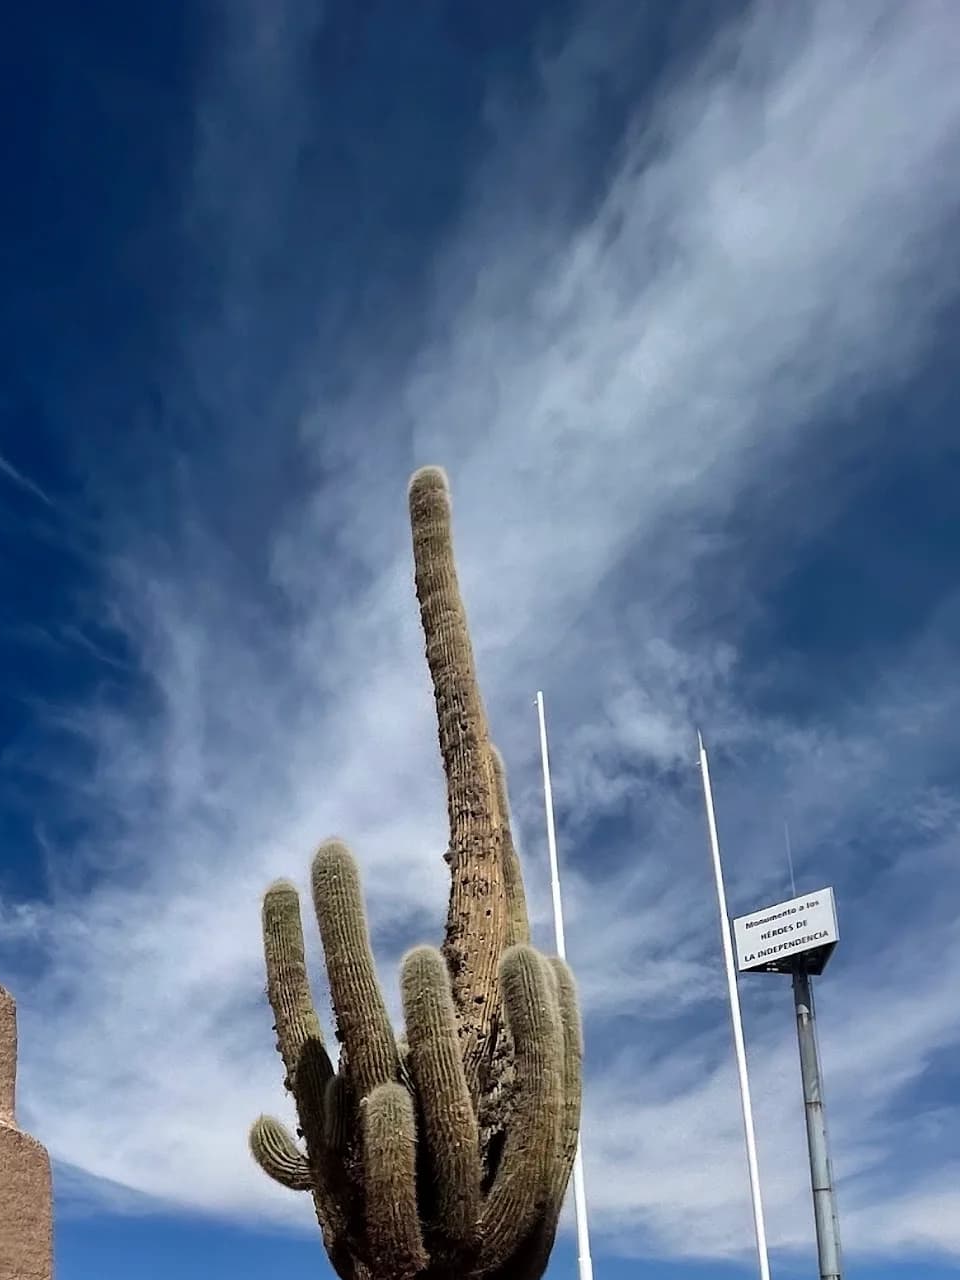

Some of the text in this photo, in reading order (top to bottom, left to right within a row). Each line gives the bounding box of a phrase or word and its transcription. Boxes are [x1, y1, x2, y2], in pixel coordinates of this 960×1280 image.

[798, 904, 805, 912] a
[806, 900, 820, 909] los
[796, 919, 808, 929] DE
[744, 930, 829, 962] LA INDEPENDENCIA
